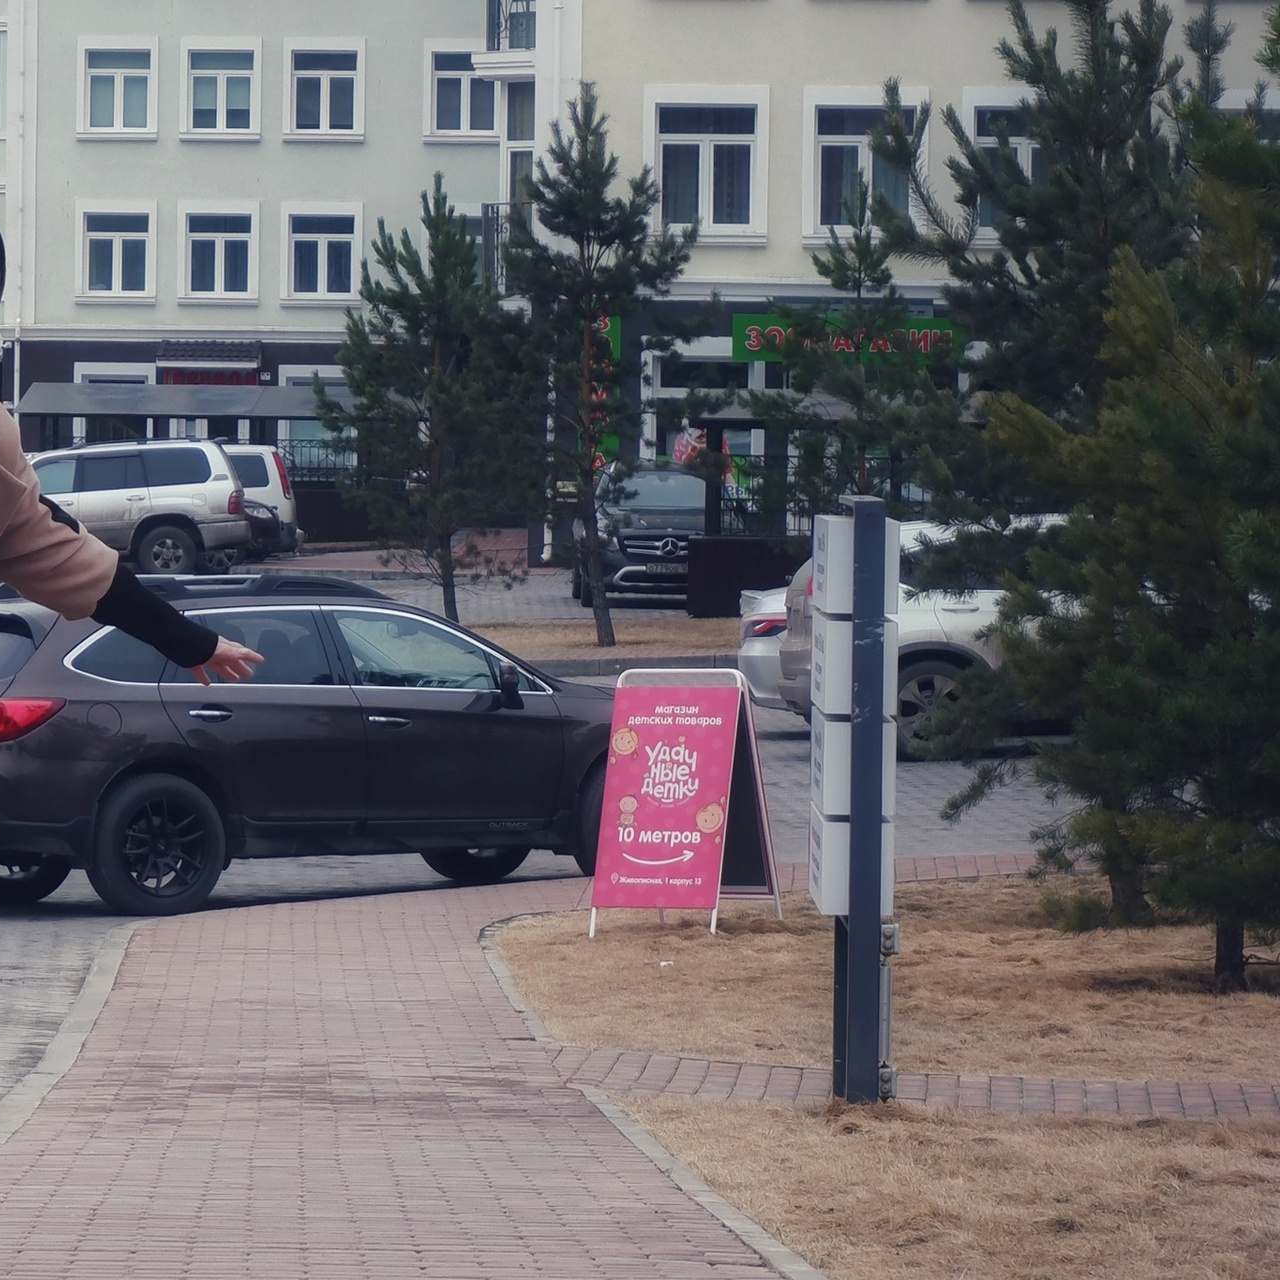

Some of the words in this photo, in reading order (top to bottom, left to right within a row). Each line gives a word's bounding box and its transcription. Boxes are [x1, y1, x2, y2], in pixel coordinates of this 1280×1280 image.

[654, 705, 699, 714] магазин
[627, 716, 674, 725] детских
[675, 716, 723, 728] товаров
[617, 826, 635, 843] 10
[638, 830, 701, 848] метров
